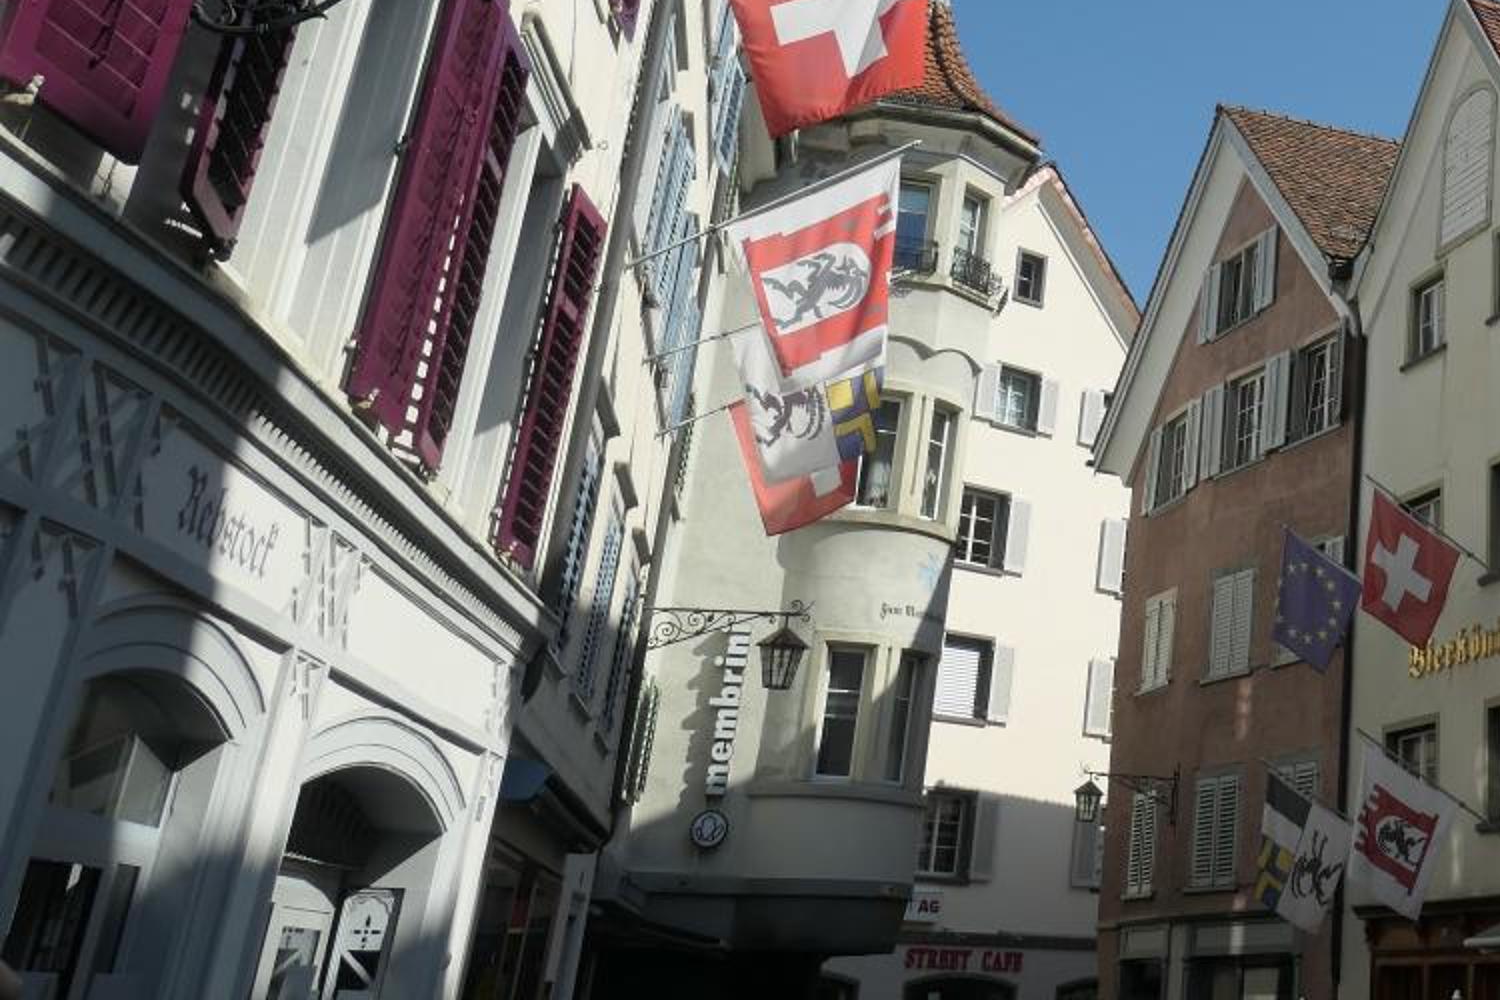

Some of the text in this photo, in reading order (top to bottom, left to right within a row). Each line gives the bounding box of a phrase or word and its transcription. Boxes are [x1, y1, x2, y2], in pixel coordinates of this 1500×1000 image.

[178, 465, 279, 579] Rebstock
[706, 621, 751, 796] membrini
[918, 899, 940, 913] AG
[905, 947, 972, 970] STREET
